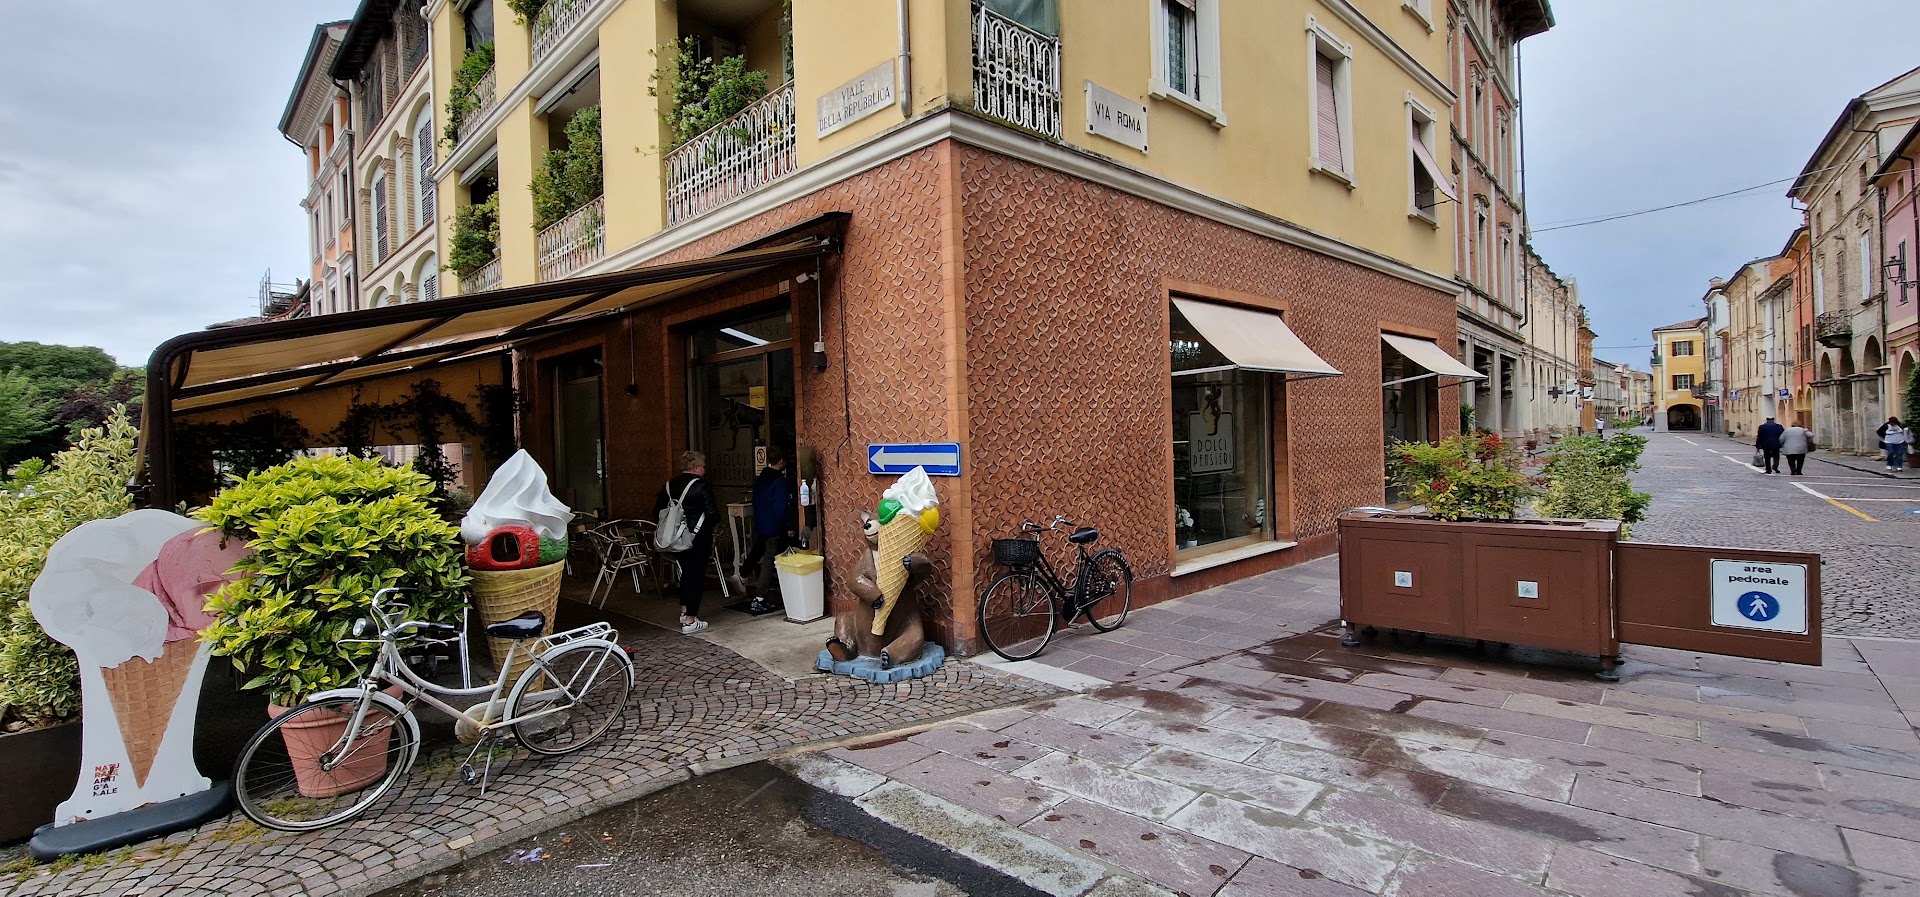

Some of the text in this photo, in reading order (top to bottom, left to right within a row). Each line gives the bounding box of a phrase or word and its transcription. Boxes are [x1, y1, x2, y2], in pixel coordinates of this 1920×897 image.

[841, 79, 865, 101] VIALE
[819, 86, 891, 131] DELLA REPUBBLICA
[1094, 101, 1142, 134] VIA ROMA
[1197, 438, 1227, 452] DOLCI
[1193, 452, 1232, 467] PENSIERI
[1743, 566, 1772, 574] area
[1728, 575, 1790, 586] pedonale
